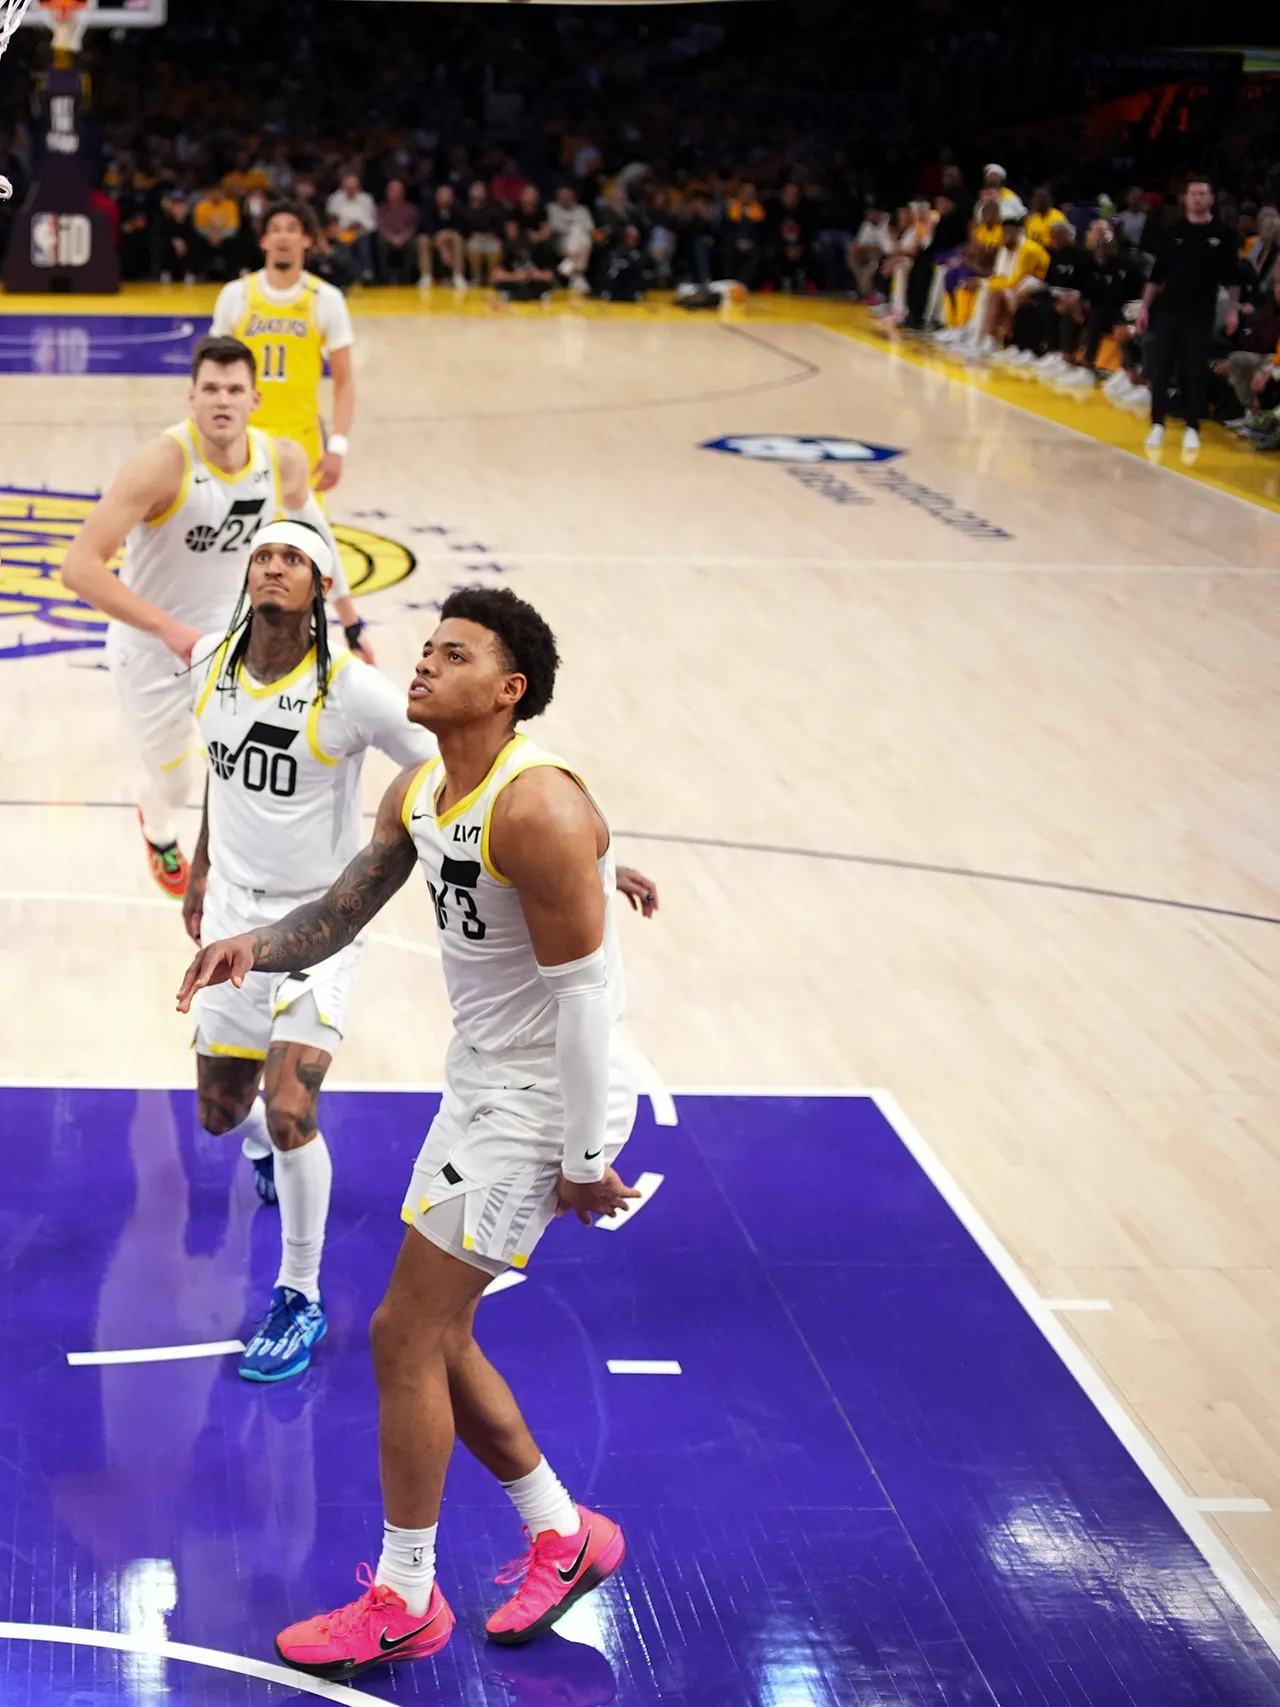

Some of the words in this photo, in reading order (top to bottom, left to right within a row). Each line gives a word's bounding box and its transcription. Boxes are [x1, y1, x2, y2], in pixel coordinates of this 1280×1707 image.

[261, 343, 287, 382] 11
[278, 695, 308, 713] LVT
[243, 746, 297, 797] 00
[453, 824, 481, 844] LVT
[455, 888, 486, 940] 3
